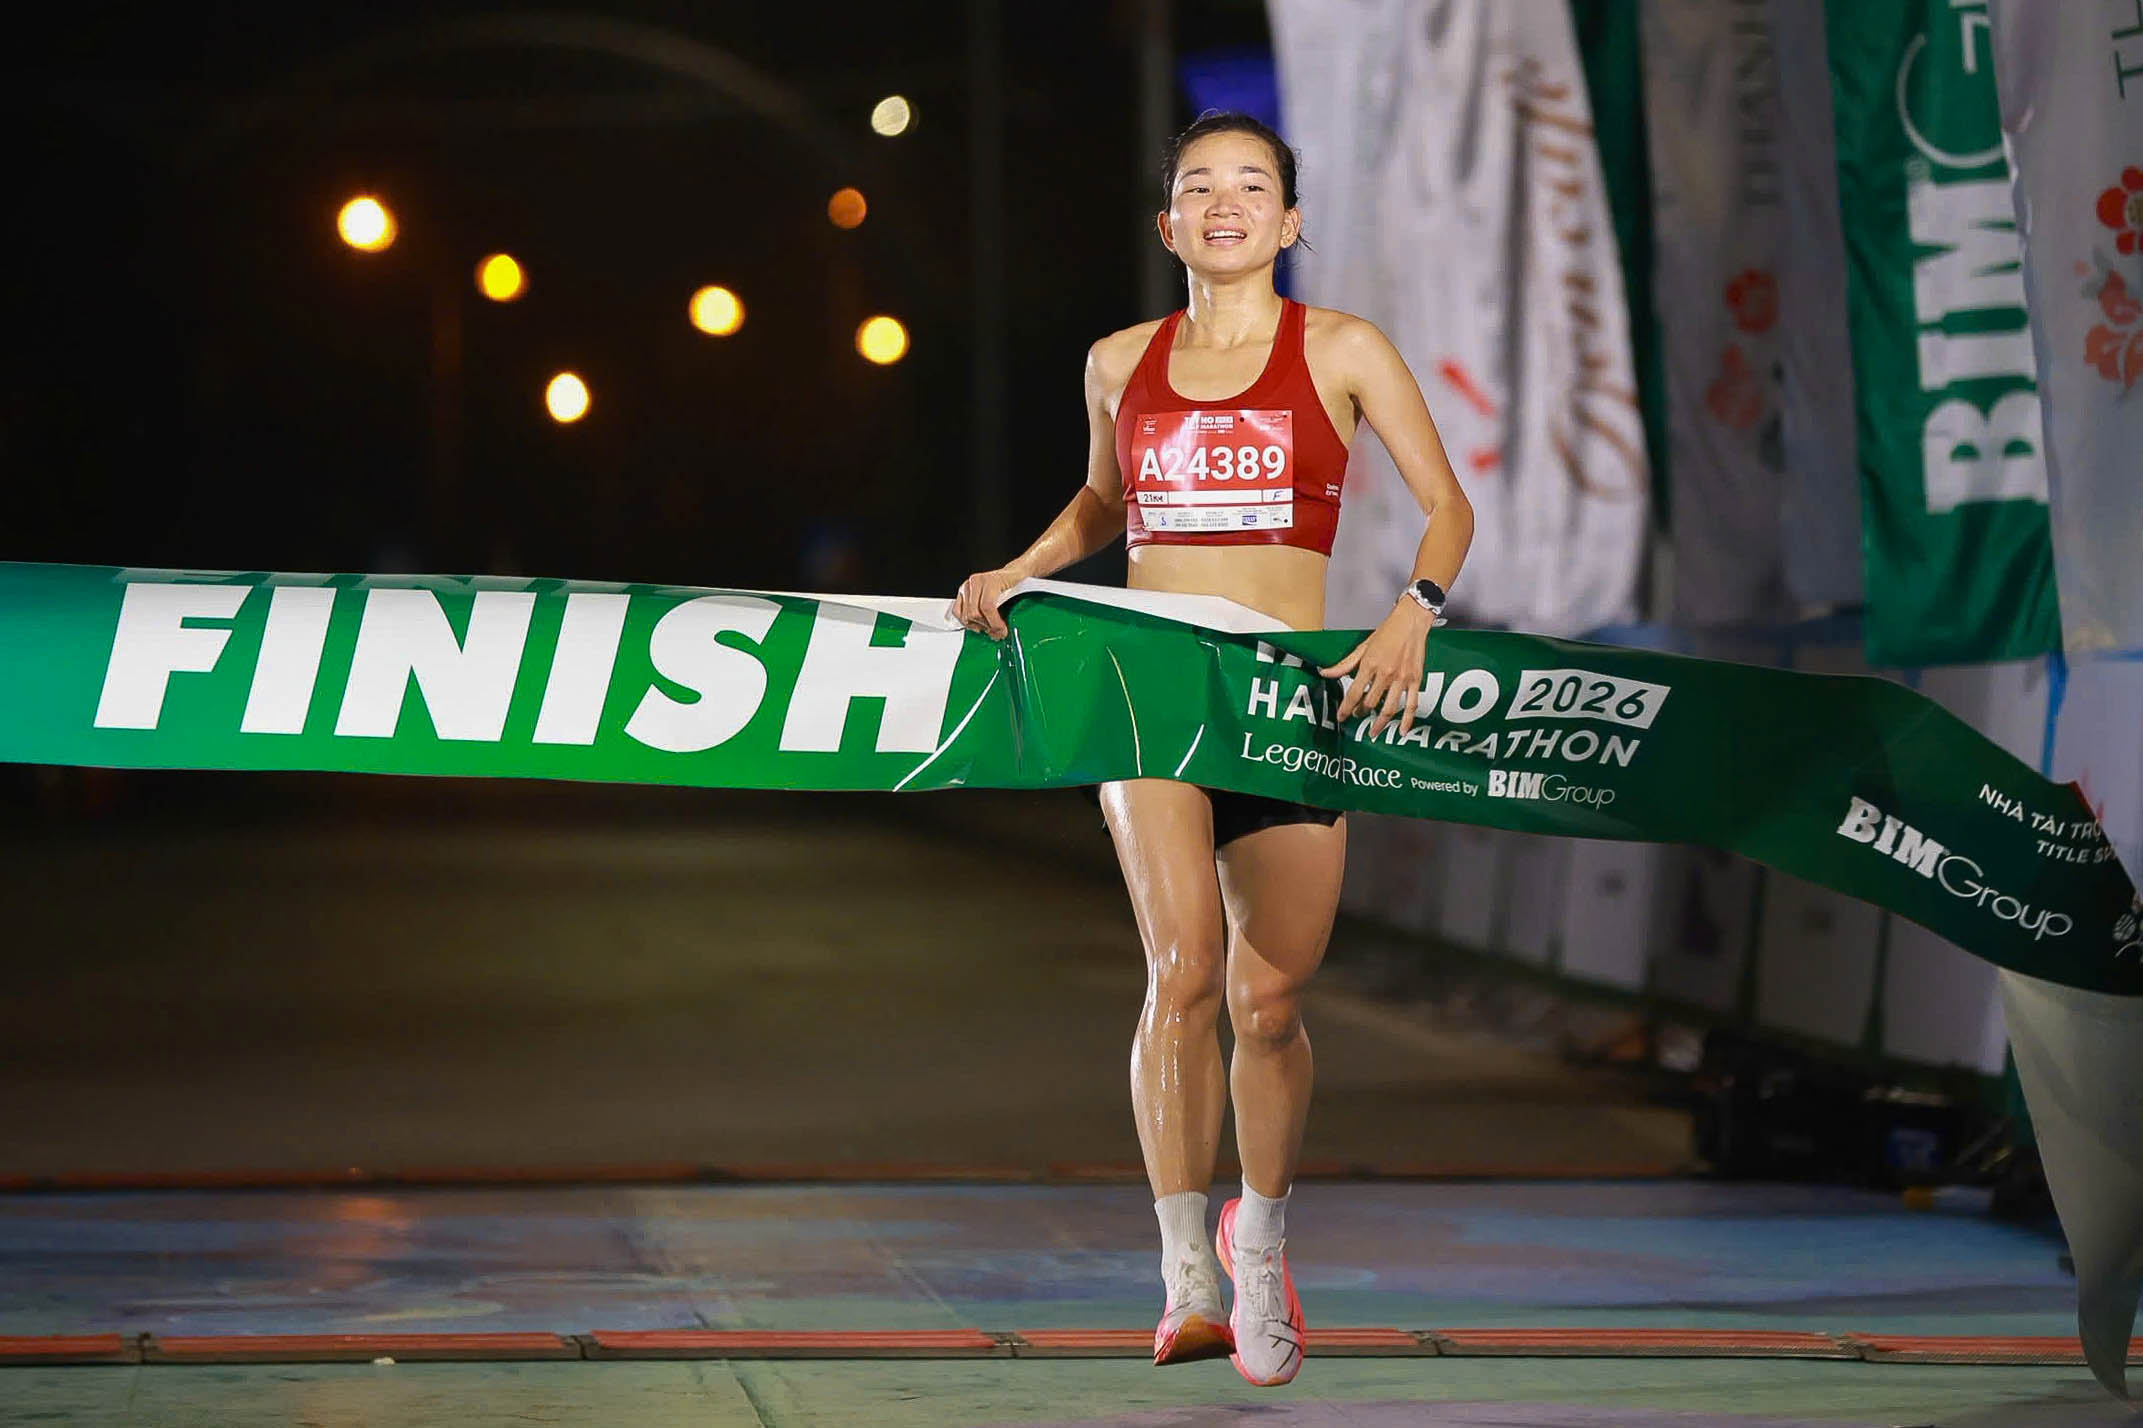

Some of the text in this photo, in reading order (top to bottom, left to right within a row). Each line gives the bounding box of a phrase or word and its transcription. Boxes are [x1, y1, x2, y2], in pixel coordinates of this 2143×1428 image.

[1138, 445, 1286, 482] A24389
[94, 583, 967, 755] FINISH
[1519, 675, 1650, 720] 2026
[1247, 677, 1641, 768] HAL MARATHON
[1411, 777, 1460, 794] Powered
[1462, 781, 1479, 798] by
[1488, 769, 1615, 811] BIMGroup
[1978, 783, 2025, 823] NHÀ
[2031, 810, 2063, 837] TÀI
[1836, 796, 2073, 941] BIMGroup
[2036, 839, 2088, 864] TITLE
